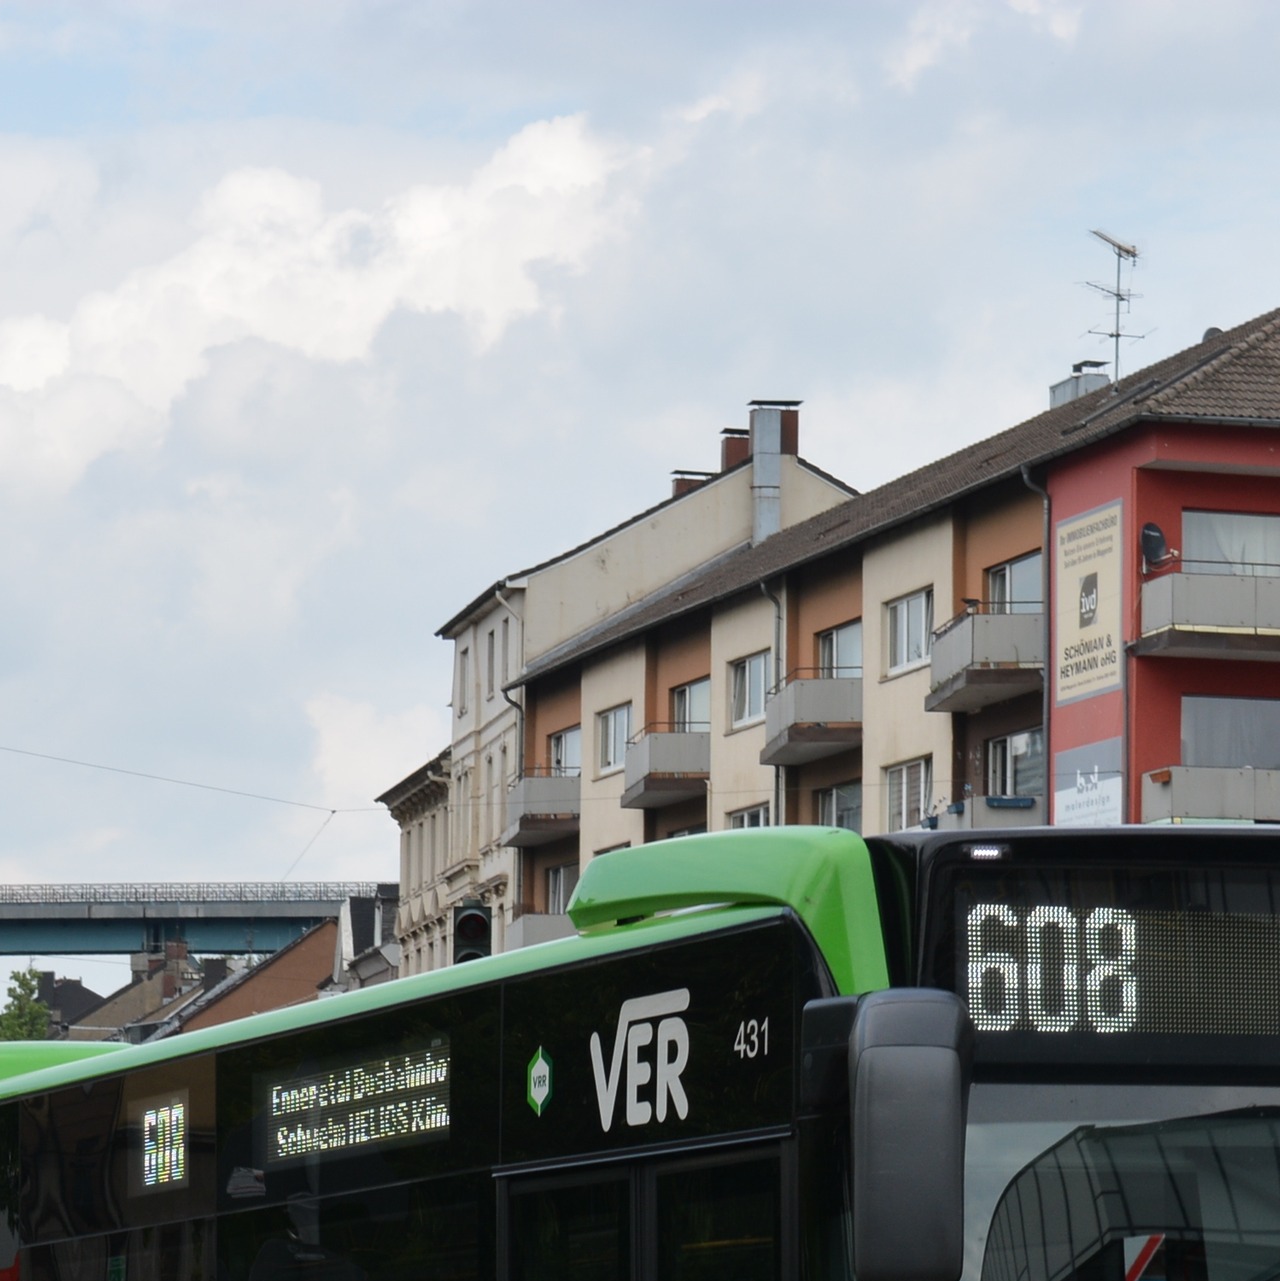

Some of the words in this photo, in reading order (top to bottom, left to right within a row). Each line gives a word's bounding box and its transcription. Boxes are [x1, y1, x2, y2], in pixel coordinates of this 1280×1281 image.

[1060, 655, 1098, 680] HEYMANN
[1101, 650, 1117, 667] oHG
[1064, 636, 1104, 661] SCHÖNIAN
[1106, 634, 1113, 648] &
[967, 903, 1137, 1033] 608
[734, 1017, 769, 1059] 431
[590, 987, 690, 1132] VER
[533, 1074, 547, 1090] VRR
